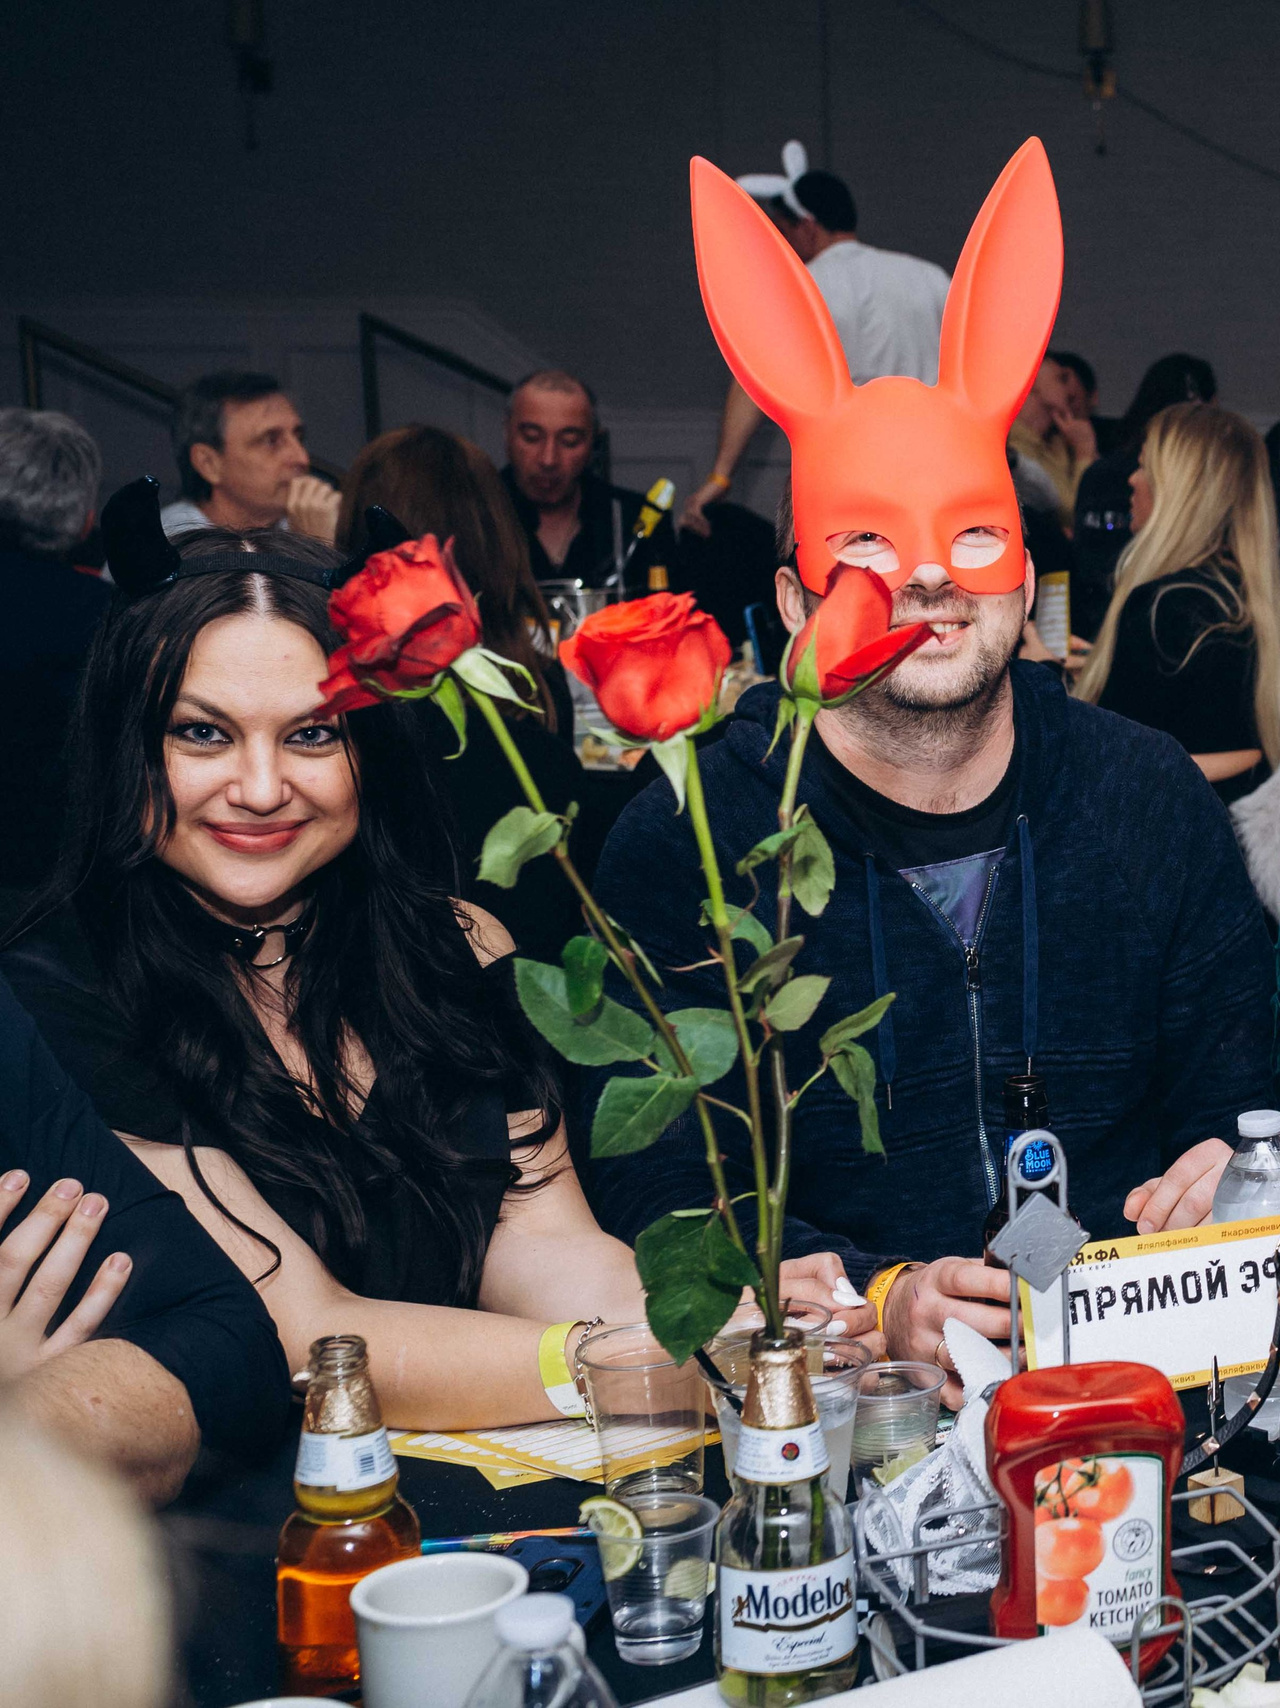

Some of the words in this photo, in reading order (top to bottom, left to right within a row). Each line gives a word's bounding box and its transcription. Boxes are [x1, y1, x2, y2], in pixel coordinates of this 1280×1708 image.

[1025, 1149, 1050, 1161] BLUE
[1025, 1159, 1052, 1169] MOON
[1137, 1236, 1199, 1250] #ляляфаквиз
[1068, 1259, 1229, 1326] ПРЯМОЙ
[1125, 1567, 1153, 1582] fancy
[746, 1576, 844, 1620] Modelo
[1097, 1581, 1153, 1607] TOMATO
[1089, 1601, 1150, 1628] KETCHU
